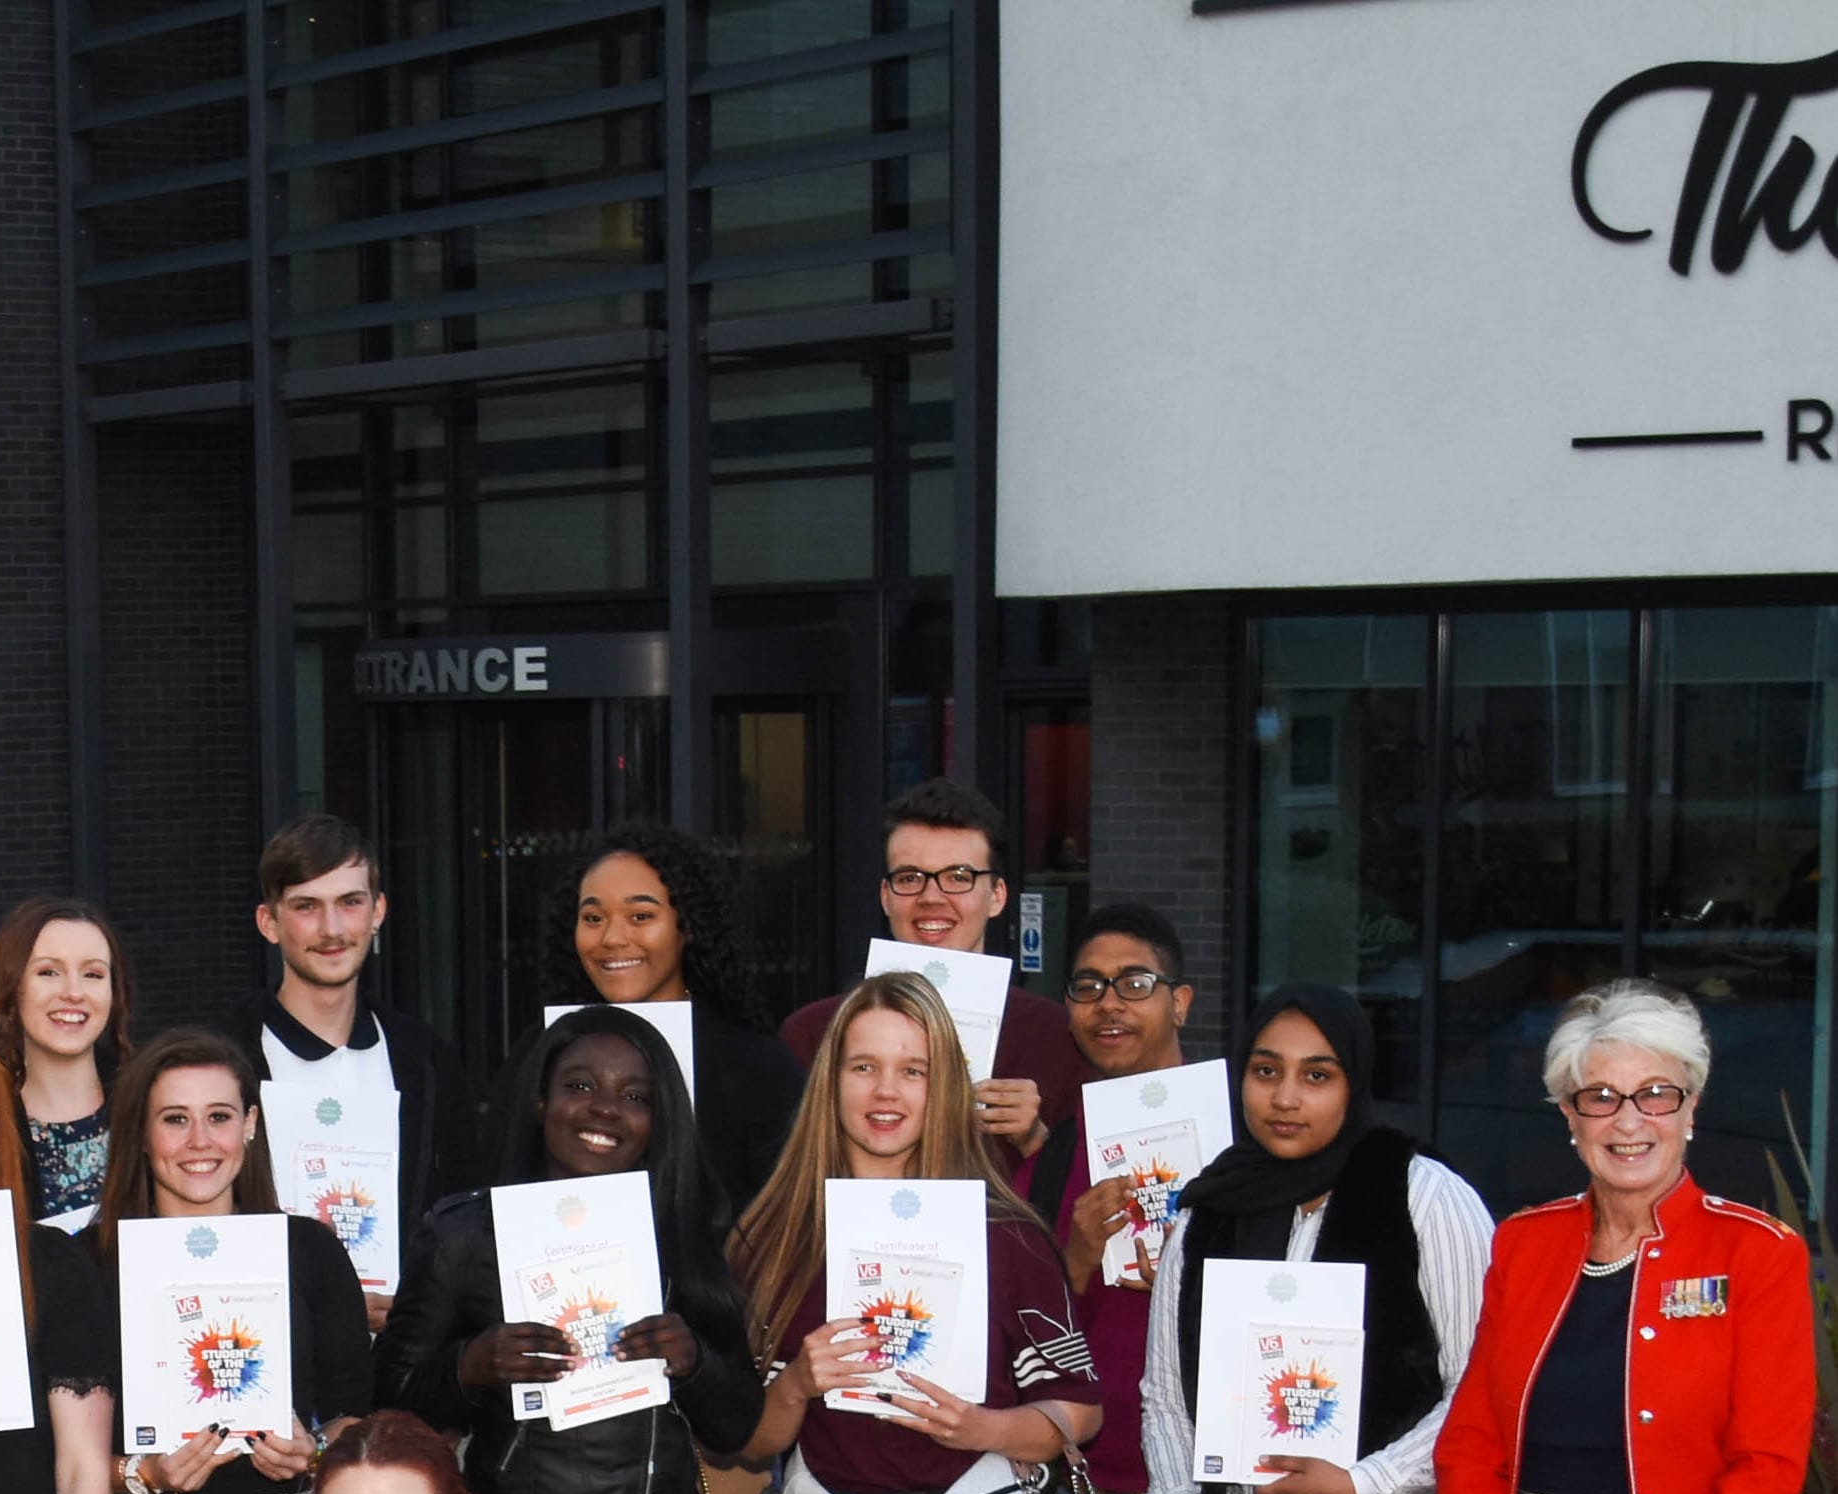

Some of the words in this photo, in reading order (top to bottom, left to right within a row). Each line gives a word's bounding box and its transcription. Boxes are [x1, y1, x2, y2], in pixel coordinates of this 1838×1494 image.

[1571, 50, 1838, 279] Th
[859, 1264, 878, 1278] V6
[176, 1298, 199, 1314] V6
[1259, 1336, 1280, 1352] V6
